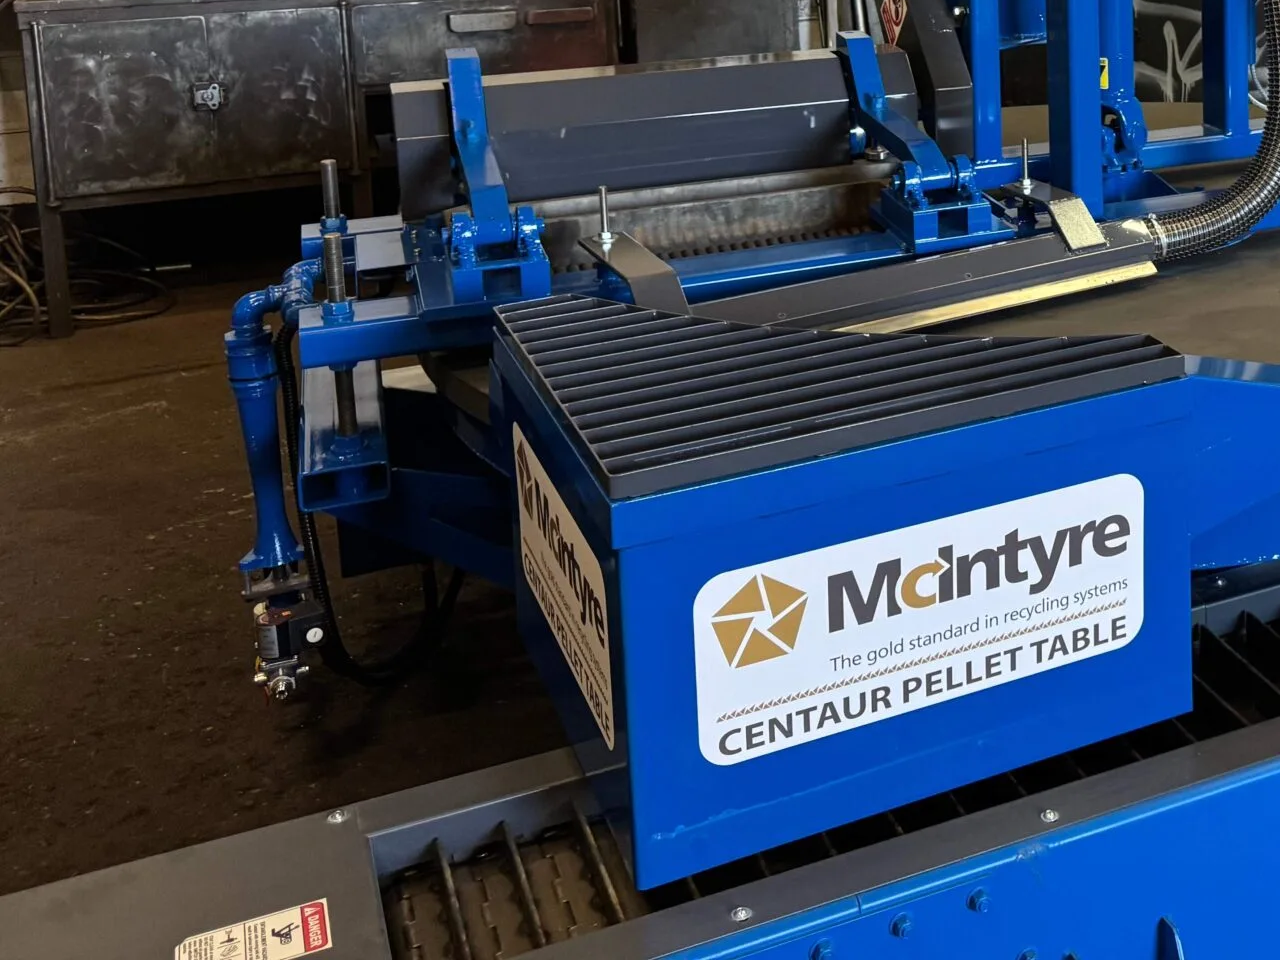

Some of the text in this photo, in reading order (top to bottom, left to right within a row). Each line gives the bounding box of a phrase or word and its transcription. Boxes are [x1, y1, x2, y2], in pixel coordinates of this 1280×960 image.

[827, 514, 1131, 633] McIntyre
[830, 578, 1128, 672] The gold standard in recycling systems
[523, 552, 556, 634] CENTAUR
[556, 612, 584, 687] PELLET
[583, 666, 611, 743] TABLE
[718, 615, 1127, 756] CENTAUR PELLET TABLE
[307, 915, 322, 948] DANGER
